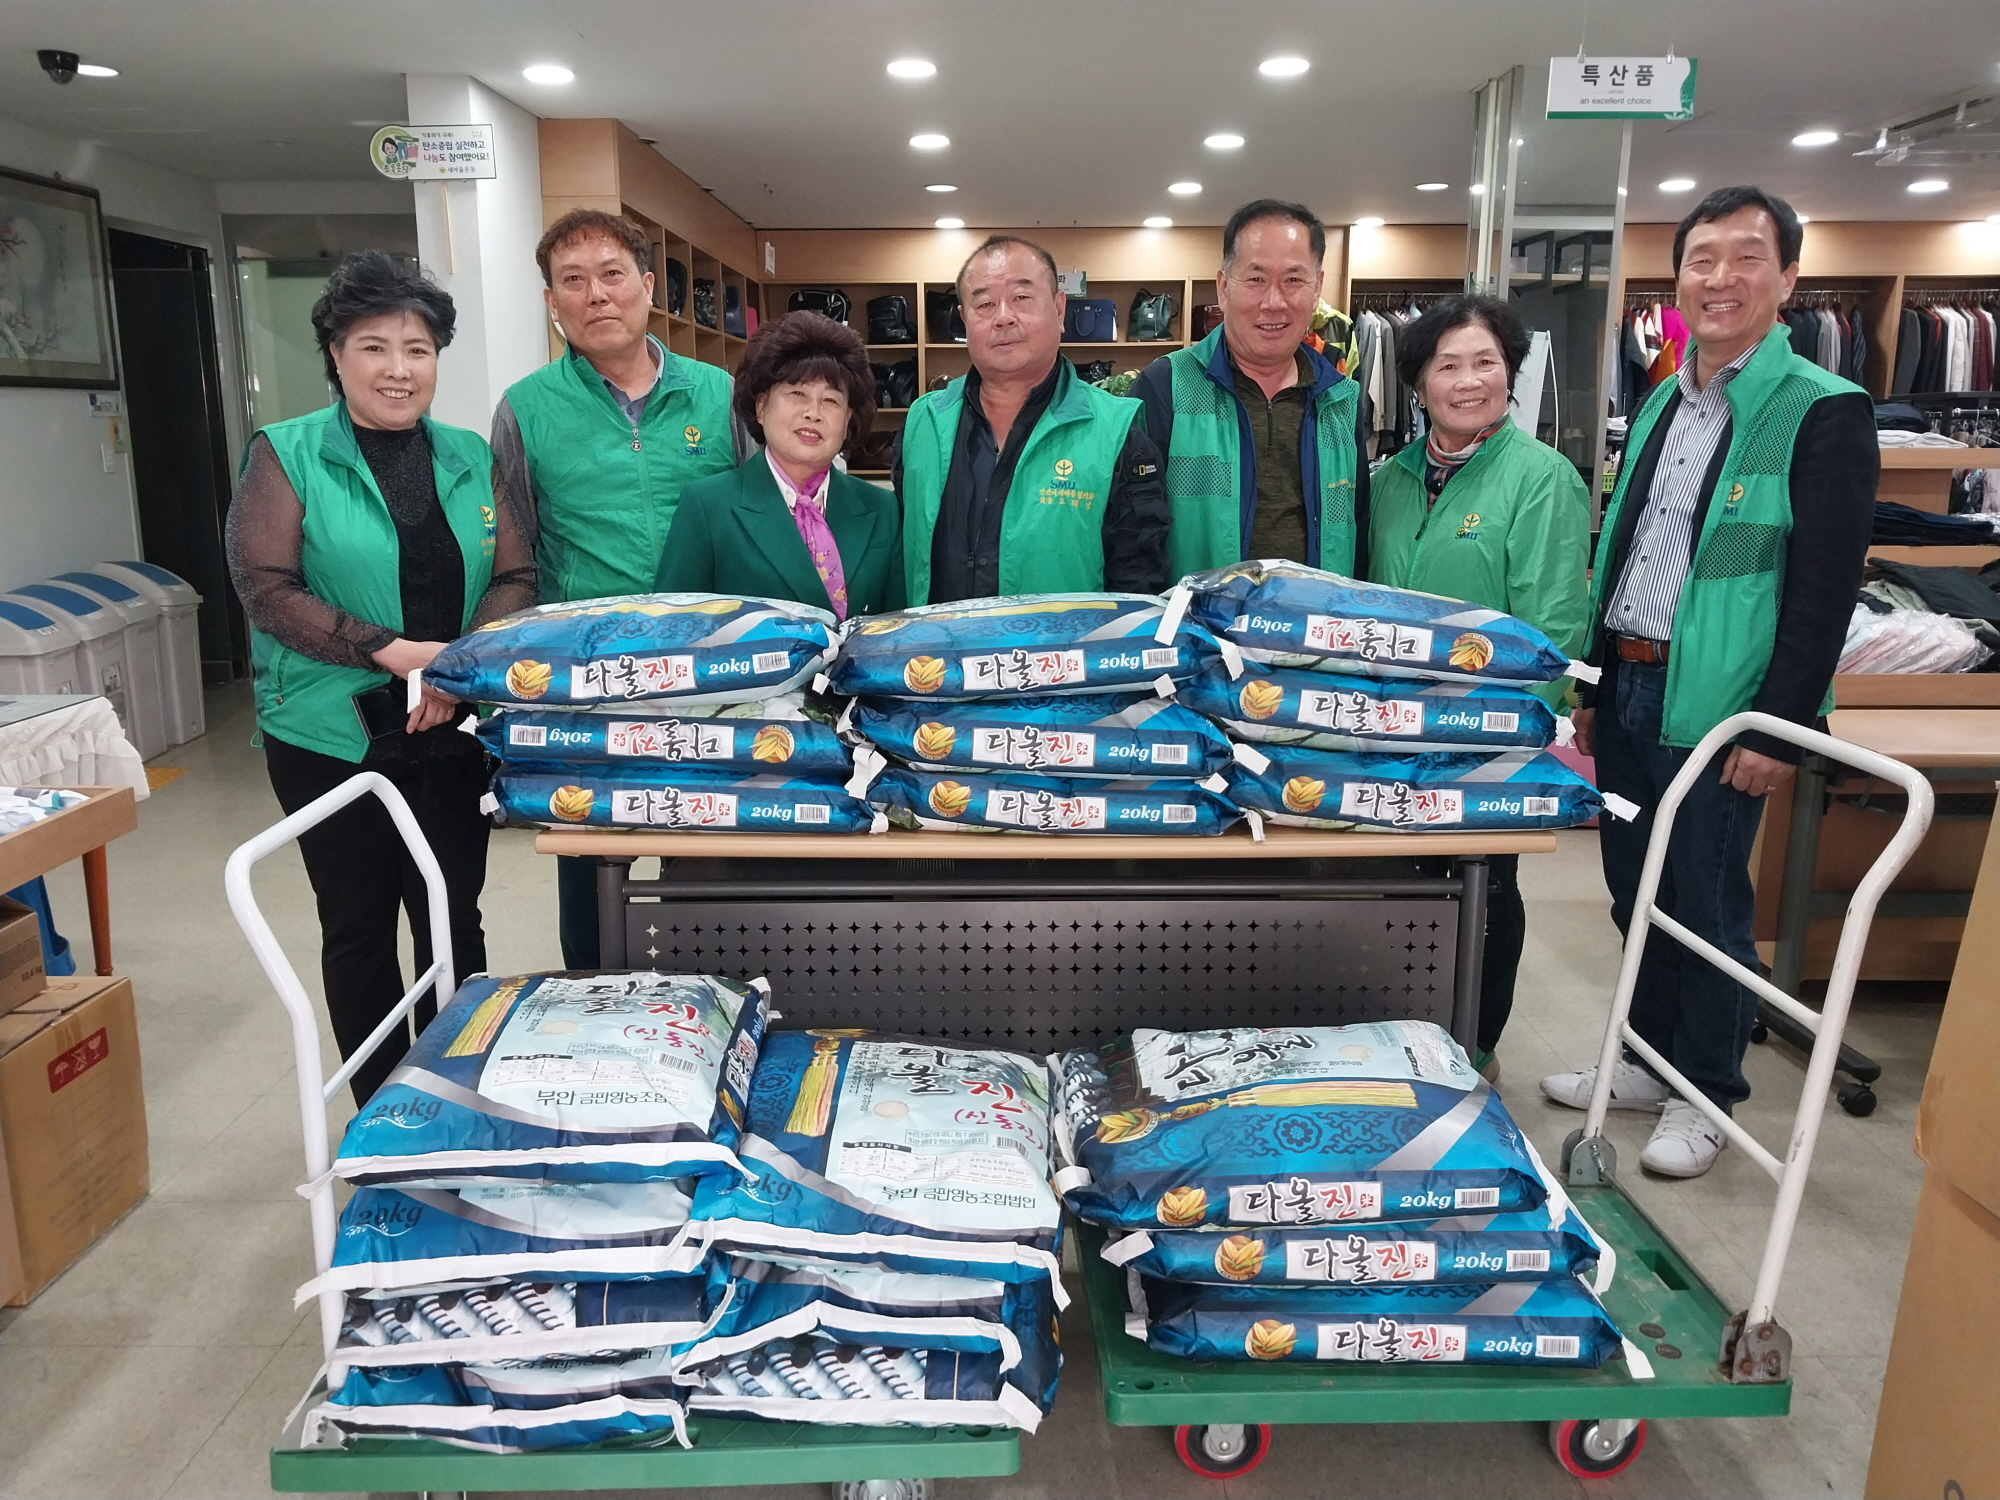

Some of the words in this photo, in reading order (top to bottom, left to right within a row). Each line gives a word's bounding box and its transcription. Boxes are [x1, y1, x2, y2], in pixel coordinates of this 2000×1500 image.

[1580, 64, 1655, 87] 특산품
[1591, 97, 1625, 105] excellent
[1626, 97, 1652, 105] choice
[422, 141, 453, 151] 탄소중립
[454, 140, 486, 150] 실천하고
[423, 153, 447, 163] 나눔도
[448, 152, 490, 162] 참여했어요!
[684, 446, 708, 456] SMU
[1049, 479, 1077, 490] SMU
[1250, 615, 1293, 634] 20kg
[1325, 618, 1417, 661] 다올진
[584, 655, 676, 698] 다올진
[708, 658, 751, 676] 20kg
[977, 649, 1065, 692] 다올진
[1098, 652, 1141, 671] 20kg
[1313, 691, 1403, 735] 다올진
[1436, 711, 1481, 730] 20kg
[548, 727, 593, 745] 20kg
[628, 719, 721, 762] 다올진
[986, 724, 1075, 769] 다올진
[1107, 743, 1150, 761] 20kg
[624, 785, 716, 828] 다올진
[749, 803, 793, 822] 20kg
[999, 788, 1086, 831] 다올진
[1118, 804, 1161, 823] 20kg
[1356, 782, 1444, 826] 다올진
[1477, 797, 1522, 815] 20kg
[622, 1024, 715, 1068] (신동진)
[370, 1096, 443, 1121] 20kg
[536, 1090, 577, 1106] 부안
[953, 1108, 1044, 1151] (신동진)
[881, 1186, 918, 1200] 부안
[1245, 1177, 1358, 1223] 다올진
[1399, 1190, 1452, 1210] 20kg
[355, 1201, 423, 1229] 20kg
[1303, 1235, 1411, 1284] 다올진
[1453, 1251, 1504, 1272] 20kg
[1334, 1319, 1442, 1365] 다올진
[1482, 1337, 1534, 1358] 20kg
